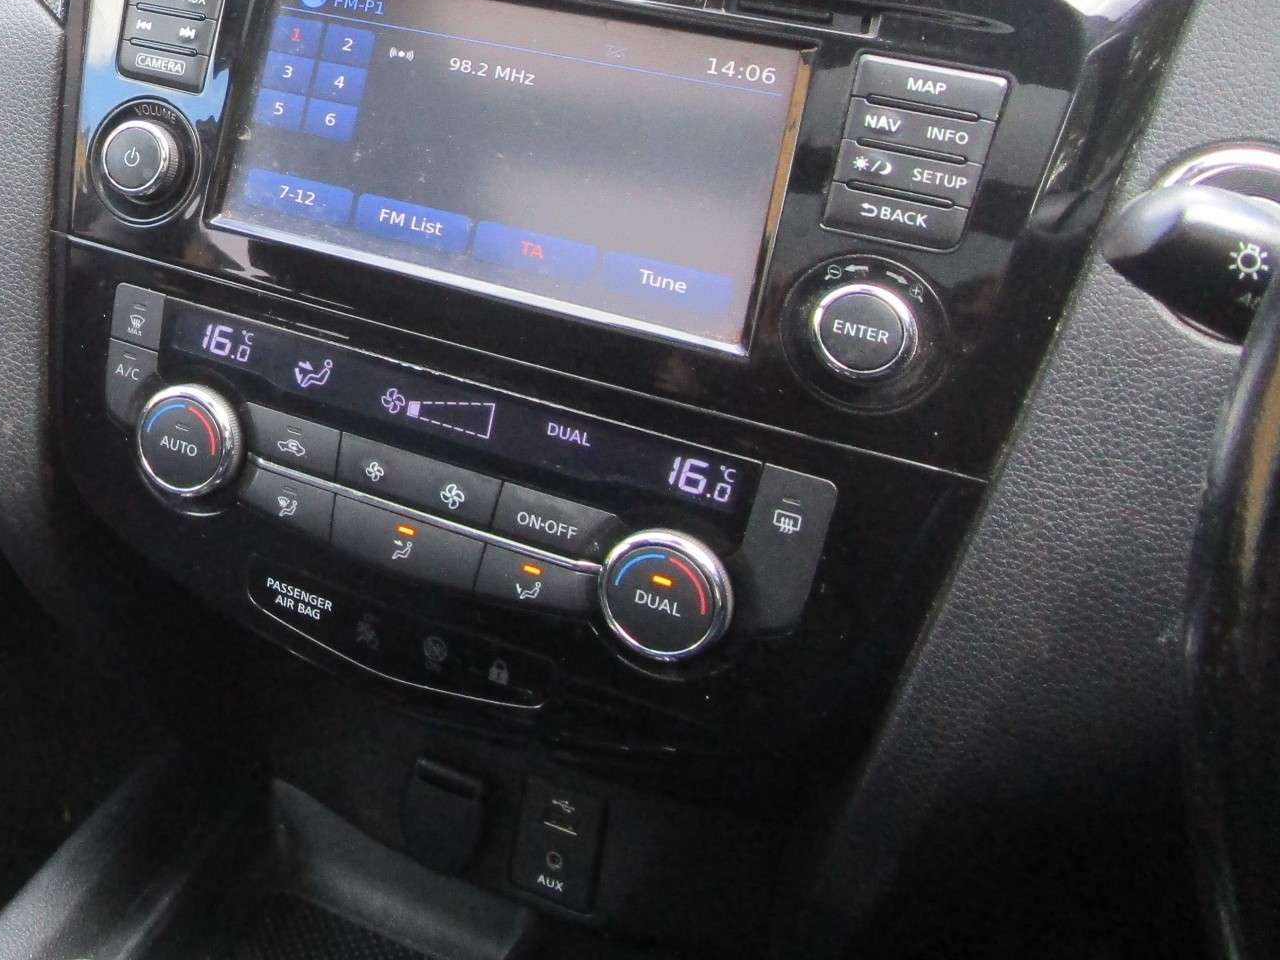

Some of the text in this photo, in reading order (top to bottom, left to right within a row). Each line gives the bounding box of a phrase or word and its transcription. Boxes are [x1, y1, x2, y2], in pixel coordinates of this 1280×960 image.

[291, 28, 302, 42] 1
[342, 38, 353, 52] 2
[137, 55, 183, 74] CAMERA
[282, 65, 294, 79] 3
[448, 57, 536, 86] 98.2 MHz
[706, 57, 776, 85] 14:06
[334, 75, 345, 89] 4
[907, 77, 947, 95] MAP
[135, 104, 177, 125] VOLUME
[273, 102, 284, 116] 5
[325, 112, 336, 127] 6
[864, 114, 901, 132] NAV
[926, 126, 969, 145] INFO
[912, 168, 968, 189] SETUP
[279, 185, 316, 206] 7-12
[379, 208, 443, 236] FM List
[880, 207, 929, 229] BACK
[521, 241, 545, 259] TA
[639, 268, 688, 294] Tune
[127, 327, 143, 337] MAX
[832, 319, 889, 345] ENTER
[115, 363, 140, 381] A/C
[547, 422, 591, 447] DUAL
[160, 435, 198, 457] AUTO
[517, 511, 578, 540] ON-OFF
[266, 577, 333, 612] PASSENGER
[635, 589, 681, 617] DUAL
[275, 594, 321, 620] AIR BAG
[537, 874, 564, 892] AUX
